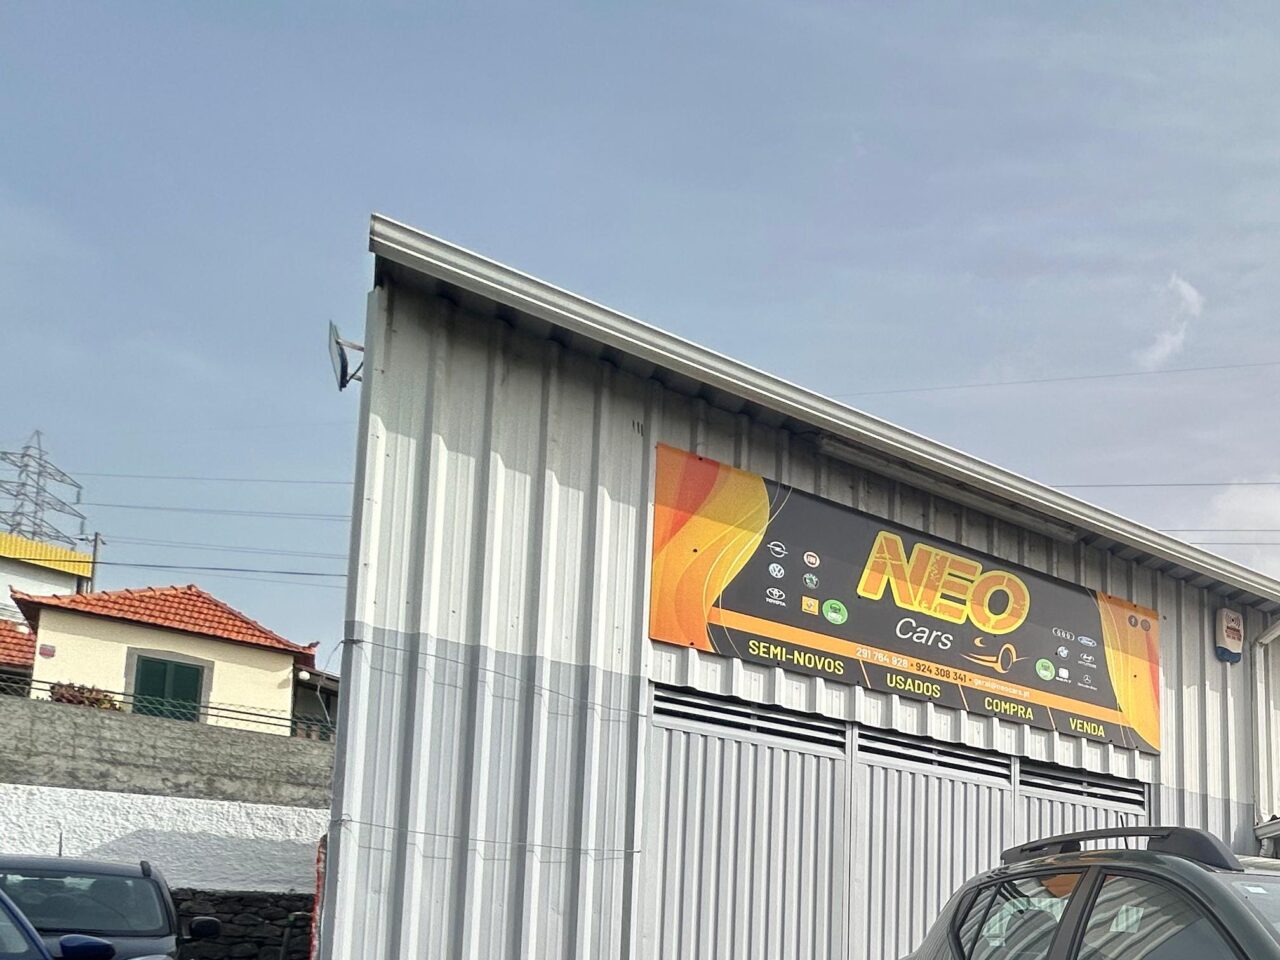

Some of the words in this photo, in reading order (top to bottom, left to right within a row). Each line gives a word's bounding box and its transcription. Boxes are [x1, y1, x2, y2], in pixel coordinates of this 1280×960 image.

[857, 530, 1030, 635] NEO
[895, 618, 954, 650] Cars
[748, 639, 845, 675] SEMI-NOVOS
[915, 662, 932, 674] 924
[934, 666, 951, 679] 308
[952, 671, 967, 683] 341
[886, 673, 941, 698] USADOS
[984, 697, 1034, 720] COMPRA
[1069, 717, 1106, 737] VENDA
